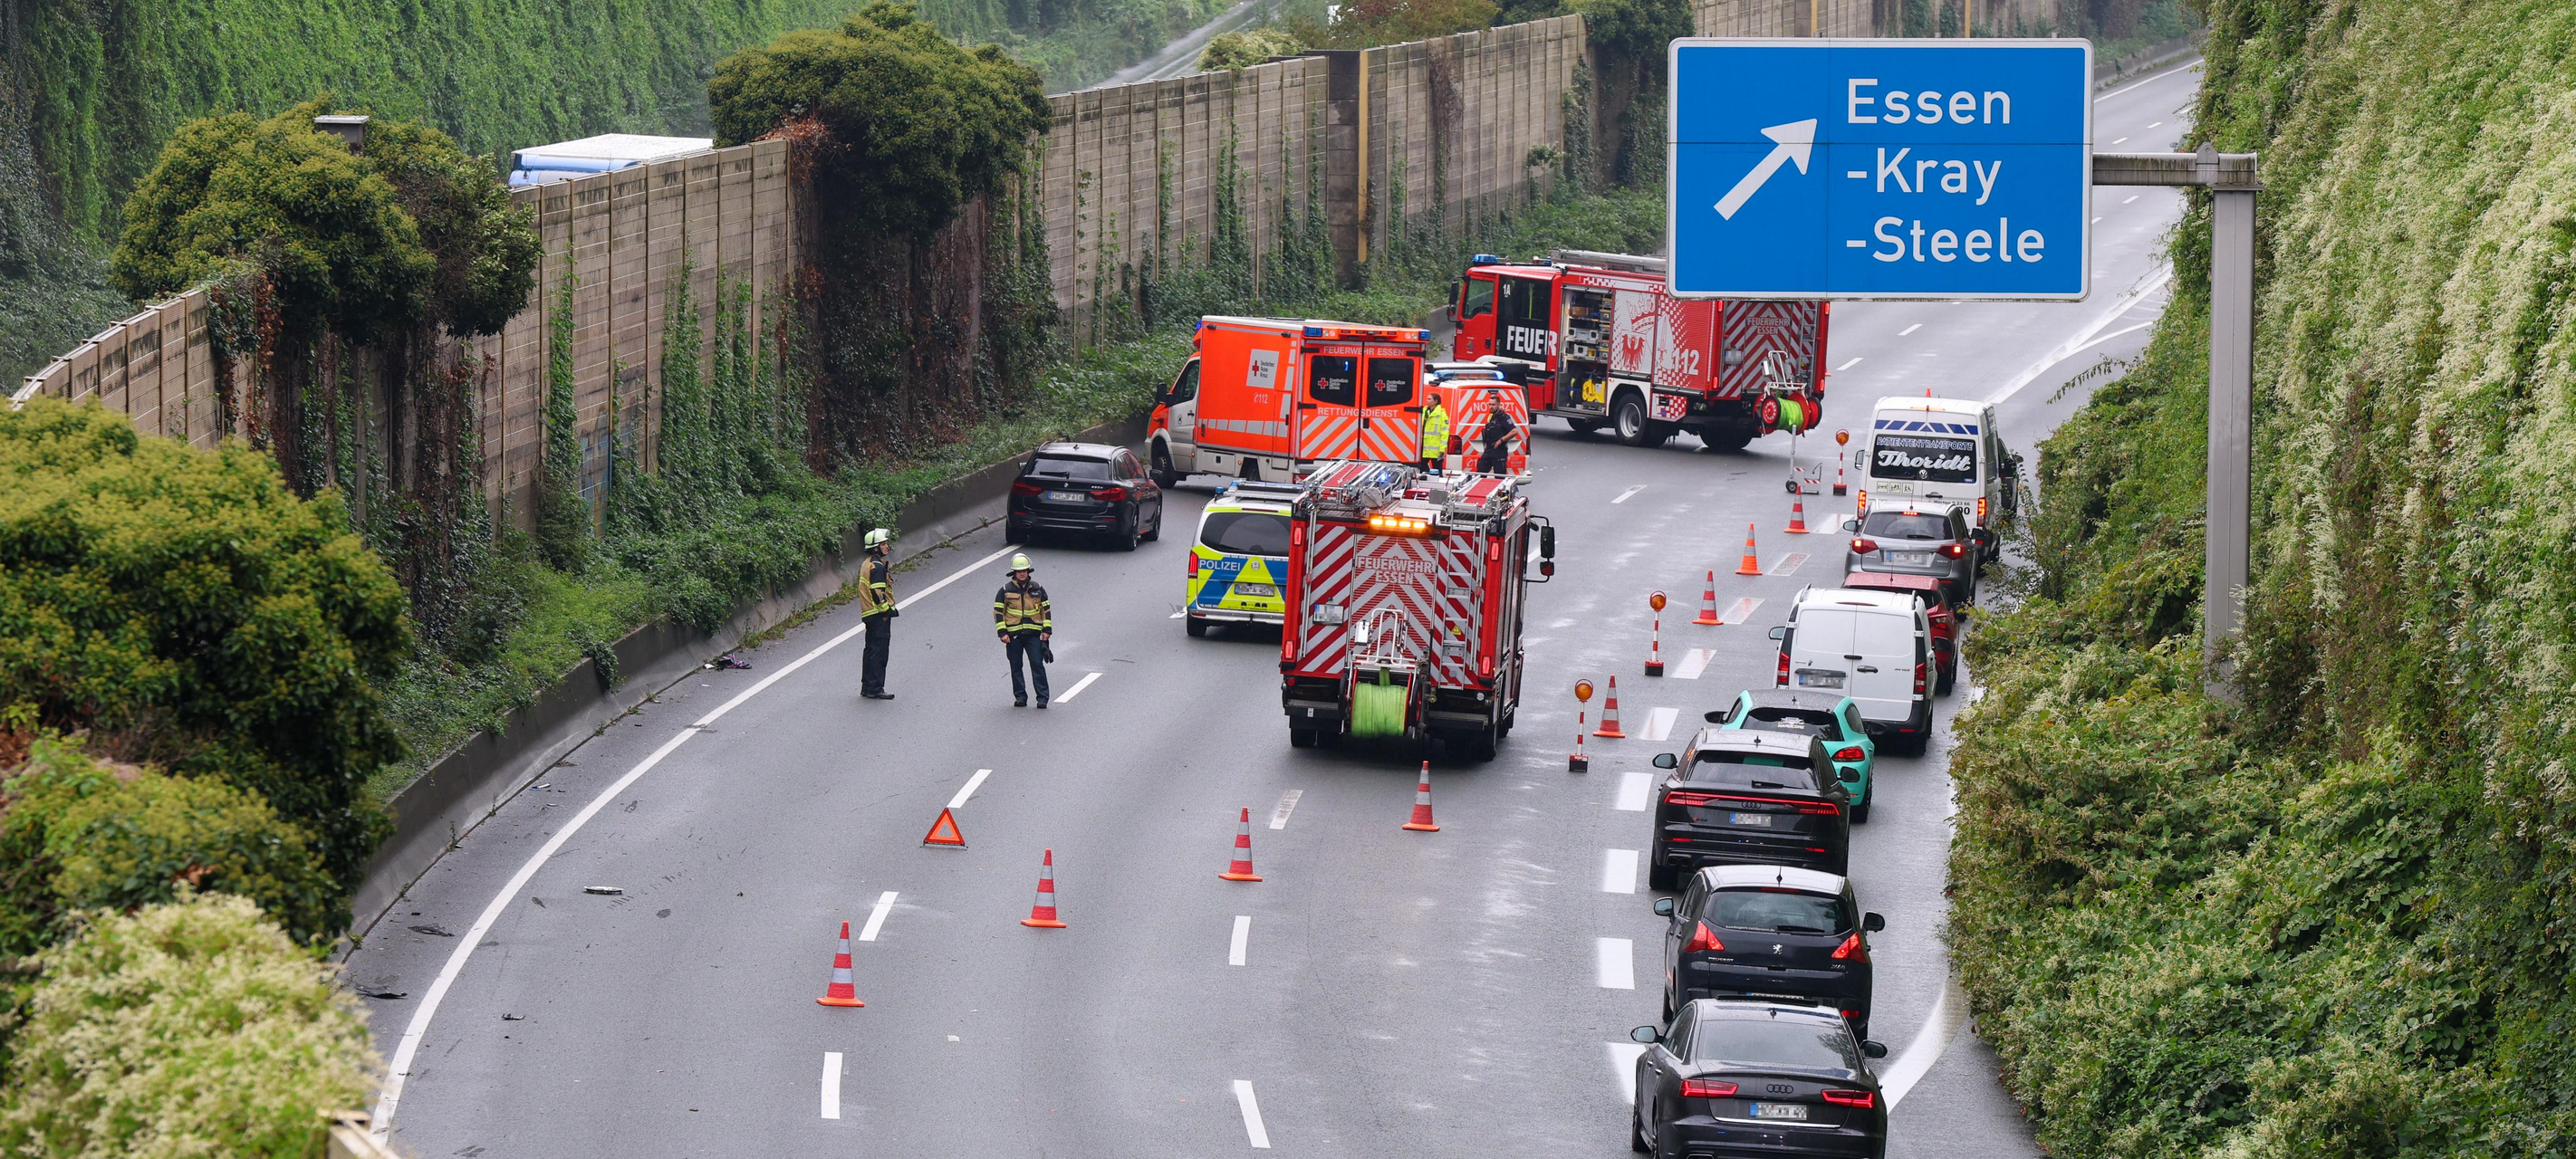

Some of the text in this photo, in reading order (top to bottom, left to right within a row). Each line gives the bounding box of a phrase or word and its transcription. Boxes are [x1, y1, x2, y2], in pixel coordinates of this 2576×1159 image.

[1848, 78, 2011, 124] Essen
[1847, 148, 2002, 206] -Kray
[1846, 216, 2044, 263] -Steele
[1504, 283, 1511, 295] 1A
[1747, 317, 1790, 326] FEUERWEHR
[1757, 326, 1779, 335] ESSEN
[1506, 325, 1558, 356] FEUER
[1323, 346, 1405, 356] FEUERWEHR ESSEN
[1671, 347, 1699, 376] 112
[1318, 407, 1399, 417] RETTUNGSDIENST
[1473, 401, 1515, 412] NORZT
[1877, 437, 1974, 451] PATIENTENTRANSPORTE
[1878, 450, 1971, 471] Thoridt
[1198, 560, 1241, 571] POLIZEI
[1358, 556, 1433, 573] FEUERWEHR
[1376, 570, 1414, 585] ESSEN
